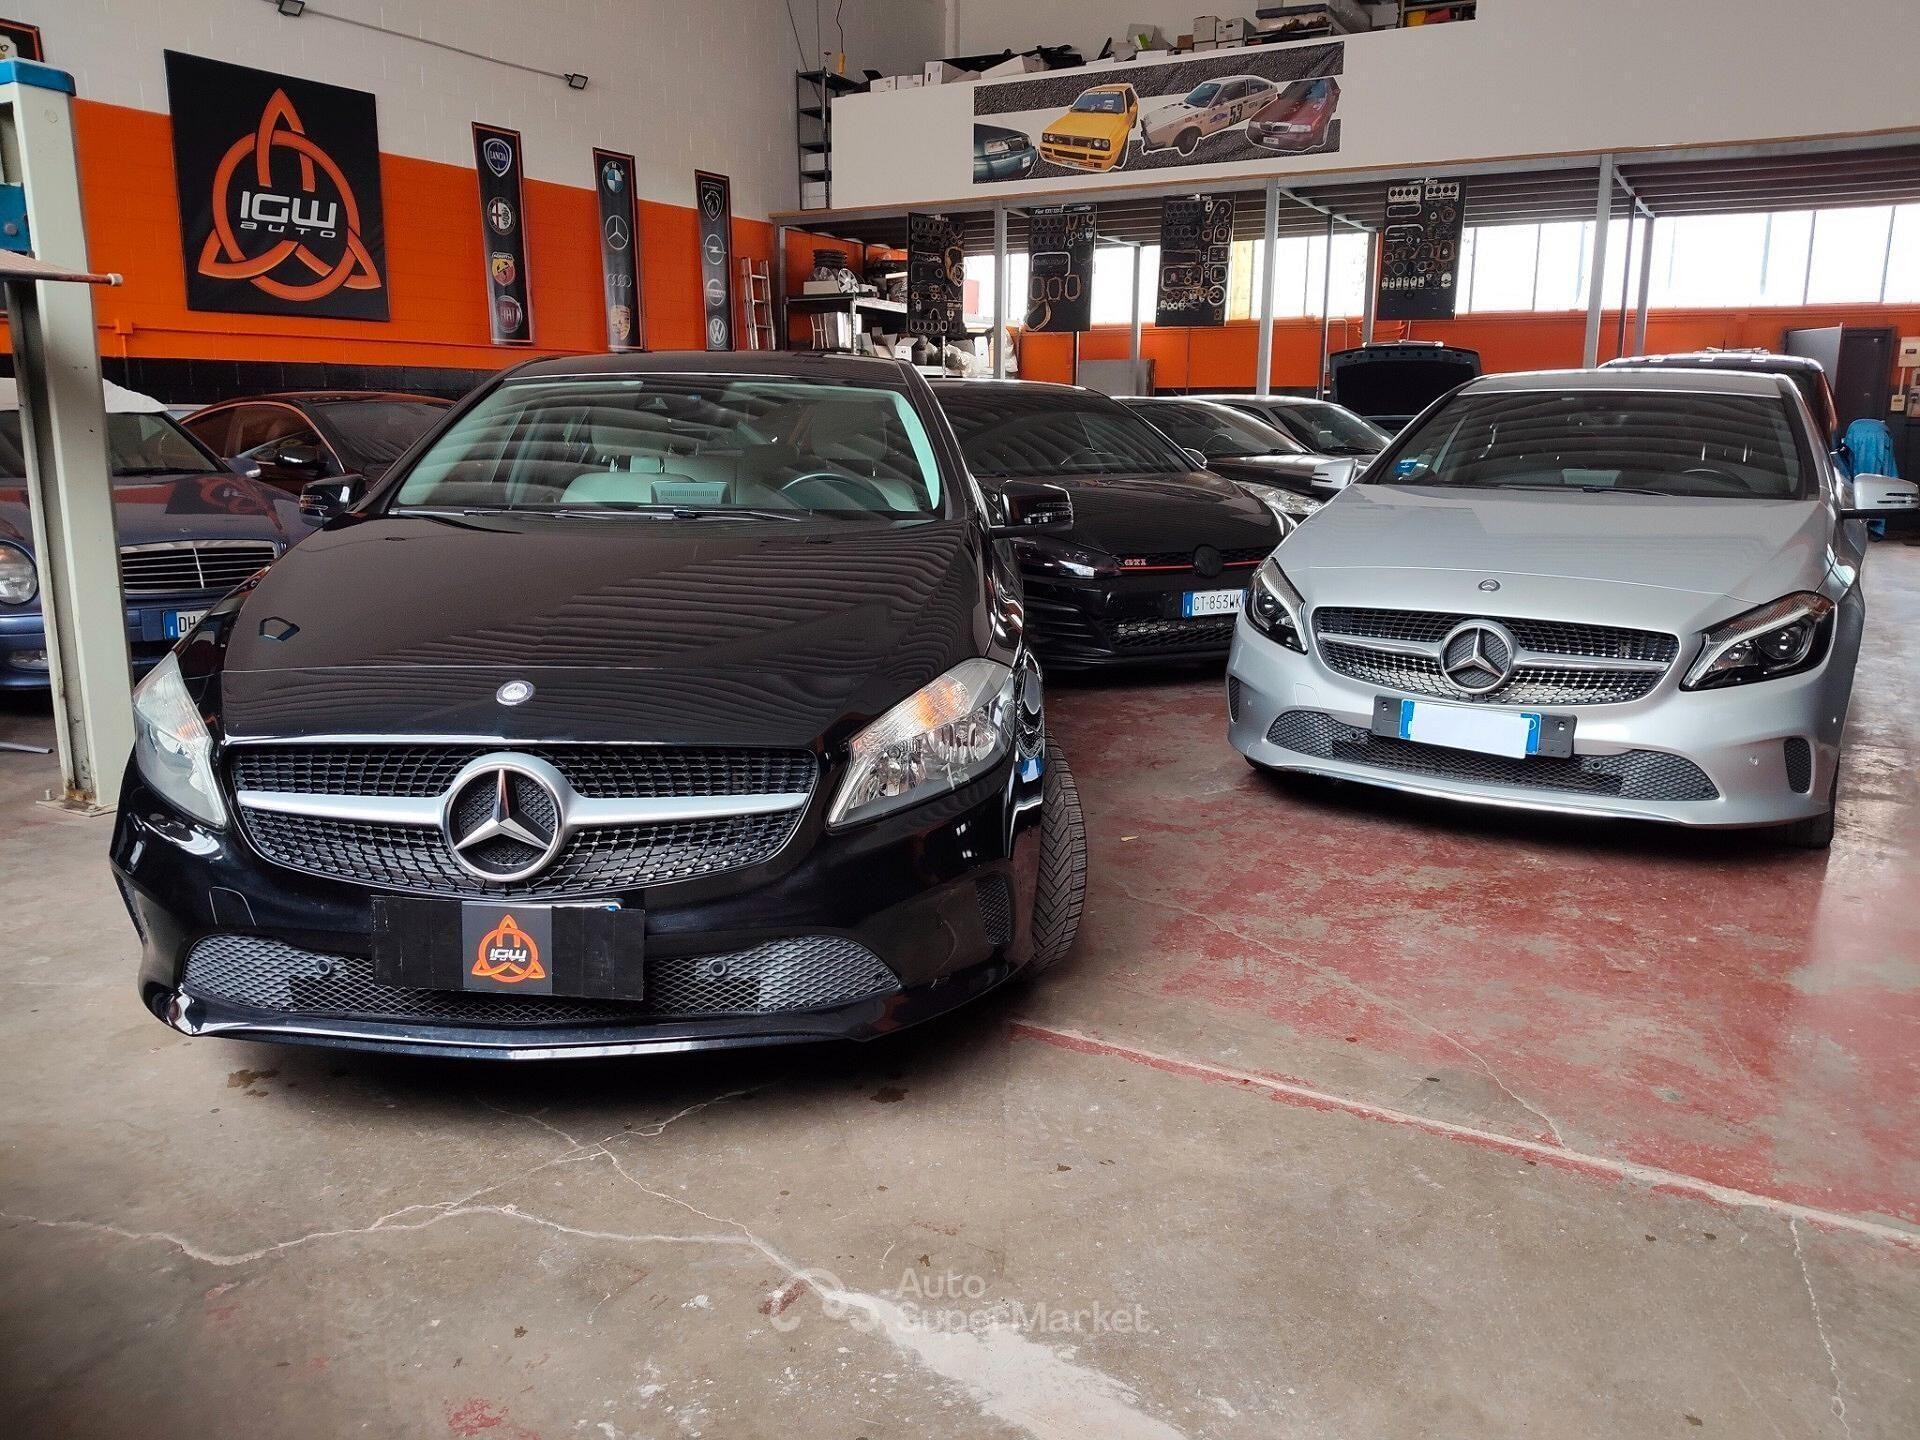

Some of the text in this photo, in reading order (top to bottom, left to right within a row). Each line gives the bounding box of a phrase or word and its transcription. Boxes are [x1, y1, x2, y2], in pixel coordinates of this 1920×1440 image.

[240, 191, 337, 228] IGW
[179, 615, 196, 632] DH
[489, 948, 527, 961] IGW
